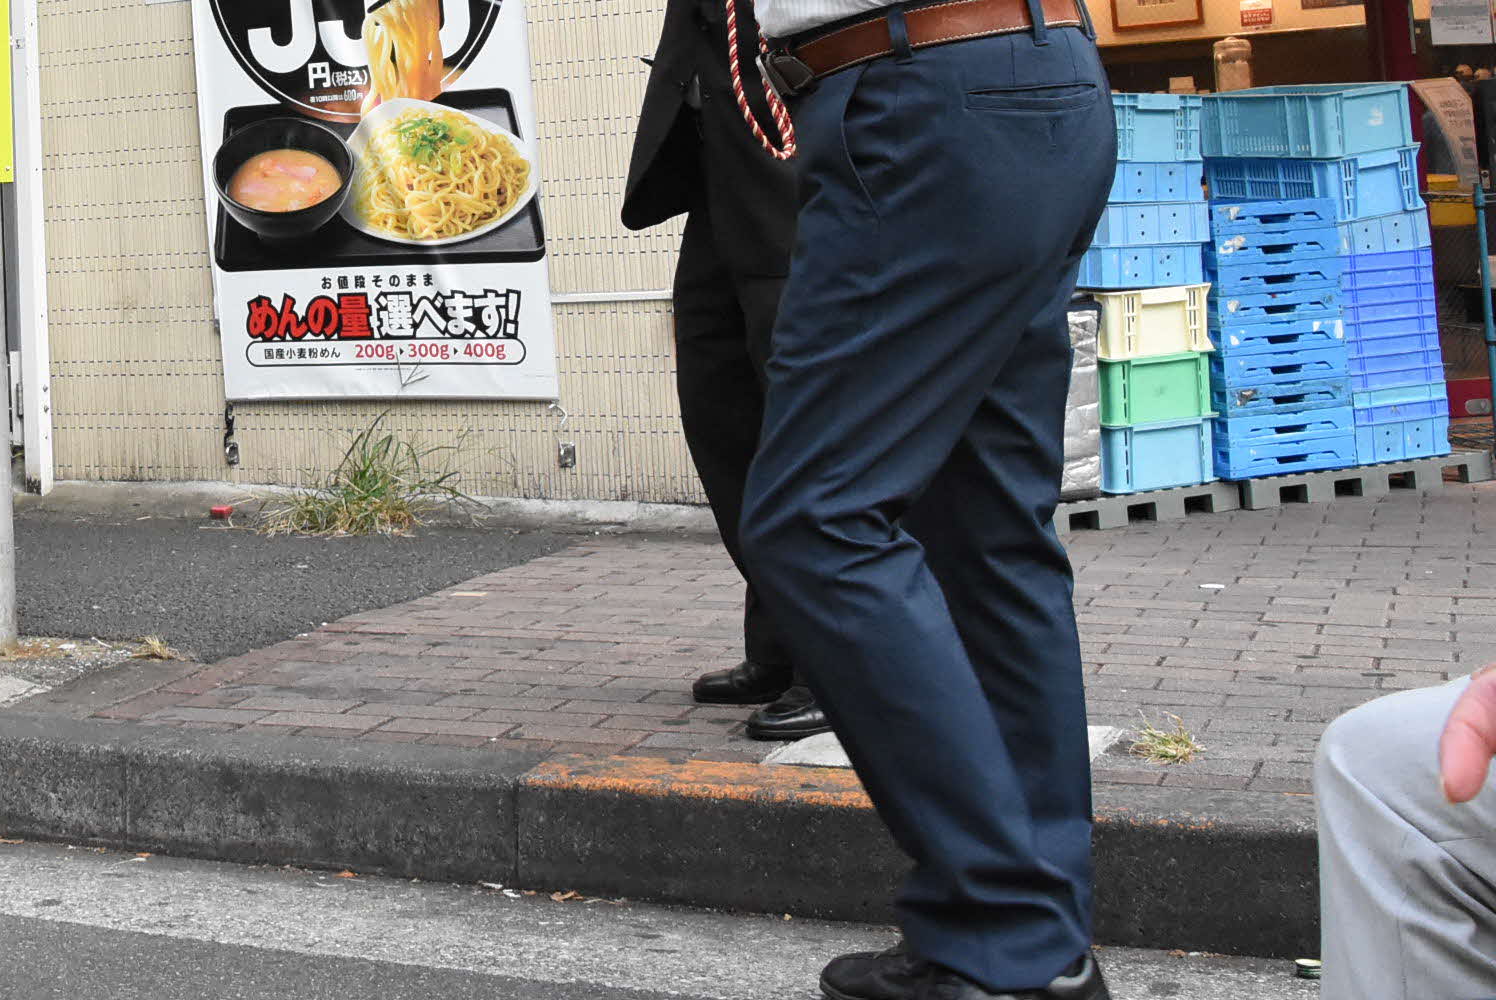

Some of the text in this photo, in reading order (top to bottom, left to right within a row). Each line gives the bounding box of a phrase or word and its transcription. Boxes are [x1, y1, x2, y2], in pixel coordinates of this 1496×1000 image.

[321, 273, 434, 290] お値段そのまま
[264, 343, 507, 360] 国産小麦粉めん 200g 300g 400g
